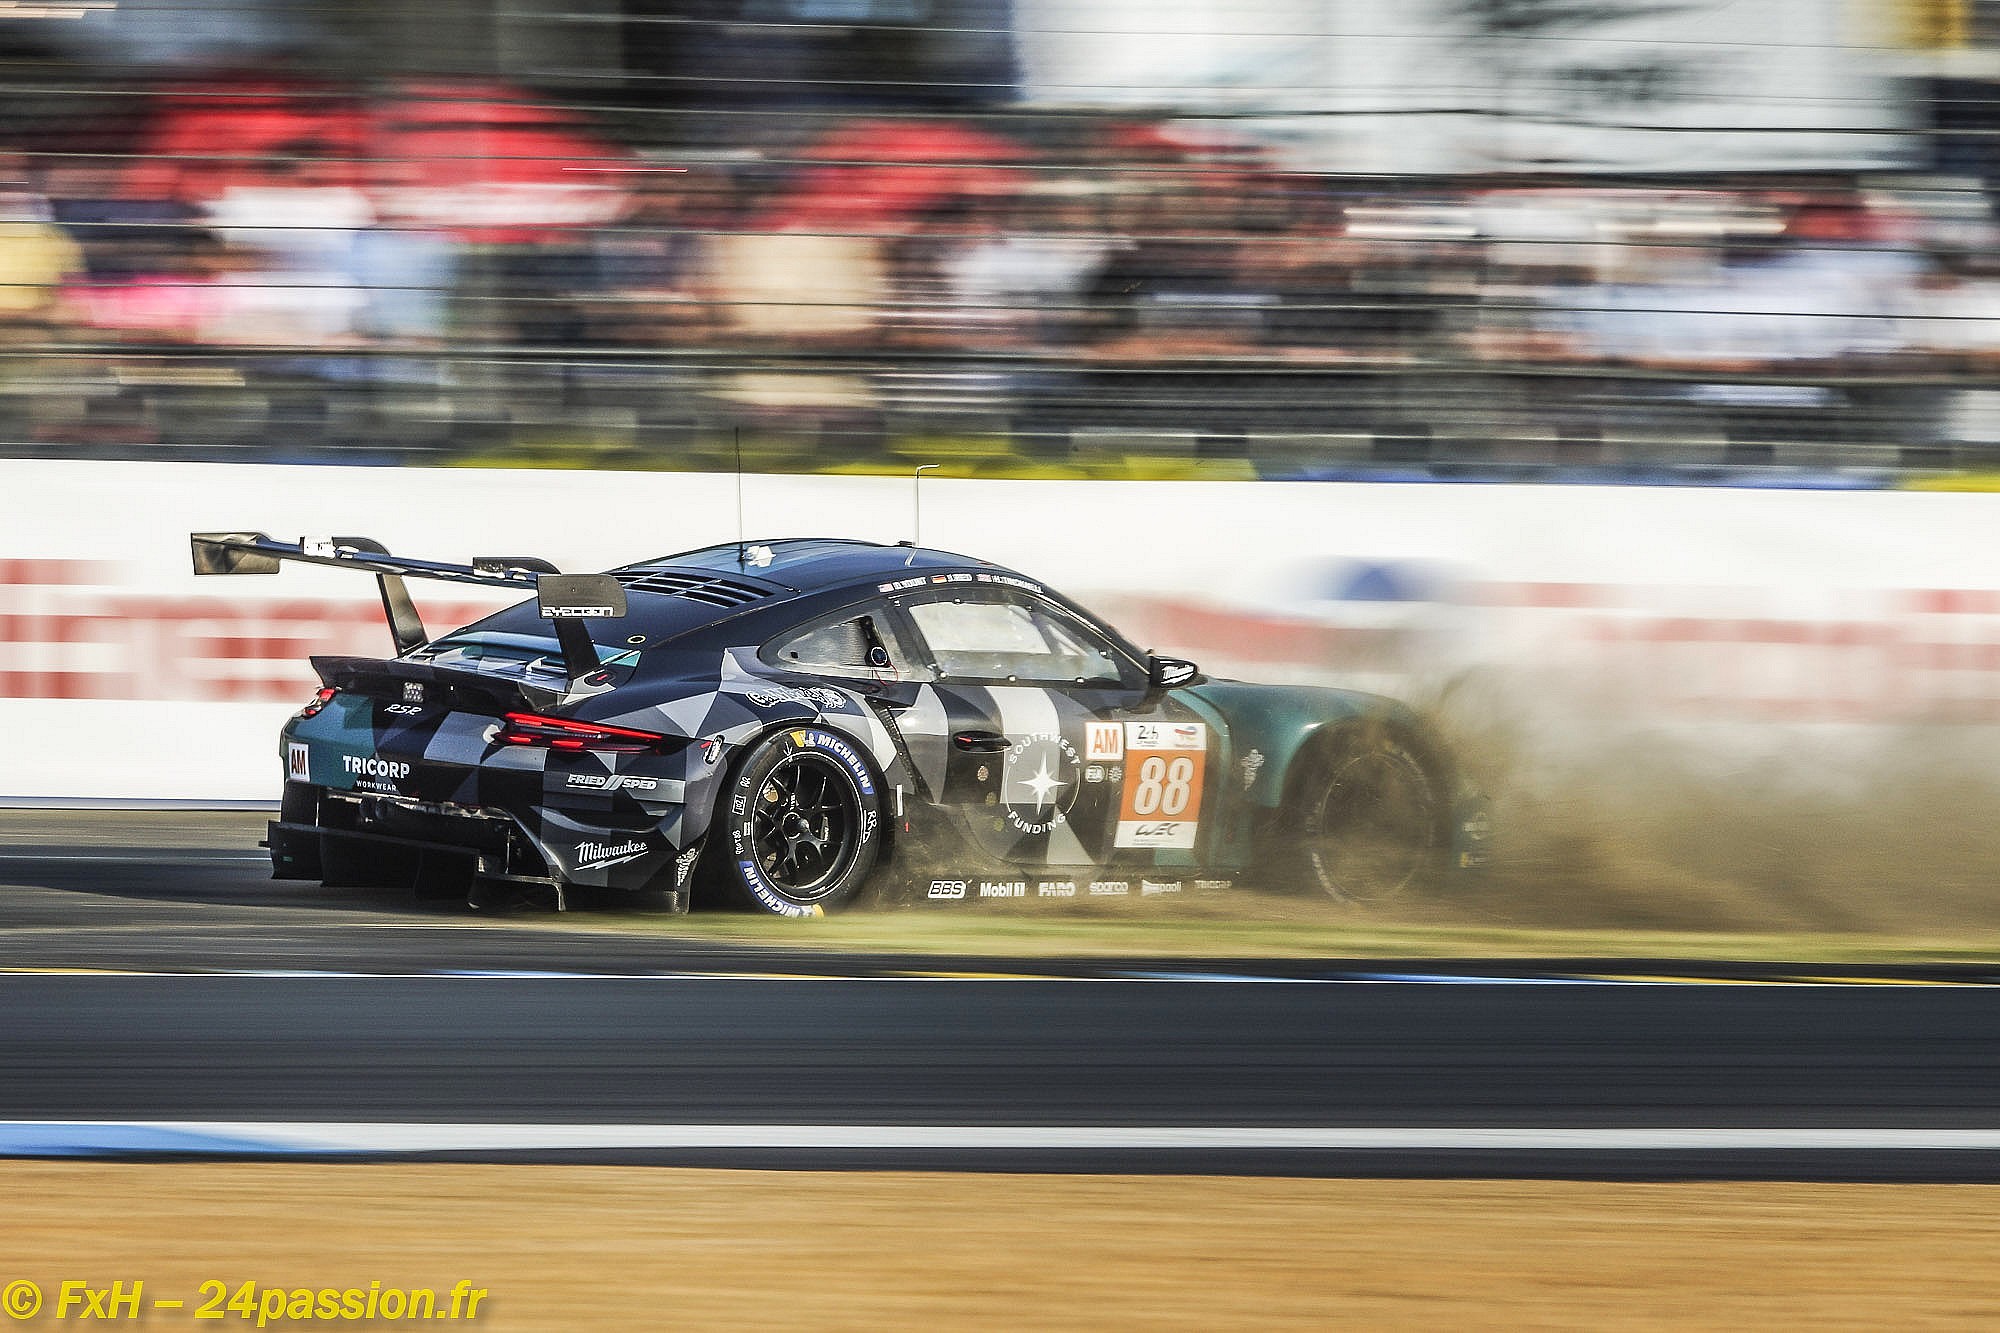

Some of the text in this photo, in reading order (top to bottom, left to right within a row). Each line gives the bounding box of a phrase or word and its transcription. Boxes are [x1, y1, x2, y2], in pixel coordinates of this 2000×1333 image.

[1008, 732, 1081, 764] SOUTHWEST
[1093, 728, 1119, 754] AM
[291, 748, 307, 776] AM
[343, 755, 411, 780] TRICORP
[817, 733, 872, 789] MICHELIN
[356, 780, 398, 792] WORKWEAR
[567, 773, 658, 790] FRIED SPED
[1134, 756, 1194, 816] 88
[1008, 810, 1066, 834] FUNDING
[1135, 822, 1181, 836] WEC
[574, 840, 648, 864] Milwaukee
[743, 865, 801, 918] MICHELIN
[928, 880, 967, 897] BBS
[980, 882, 1012, 897] Mobil
[1038, 882, 1076, 897] FARO
[1089, 881, 1129, 893] sparco
